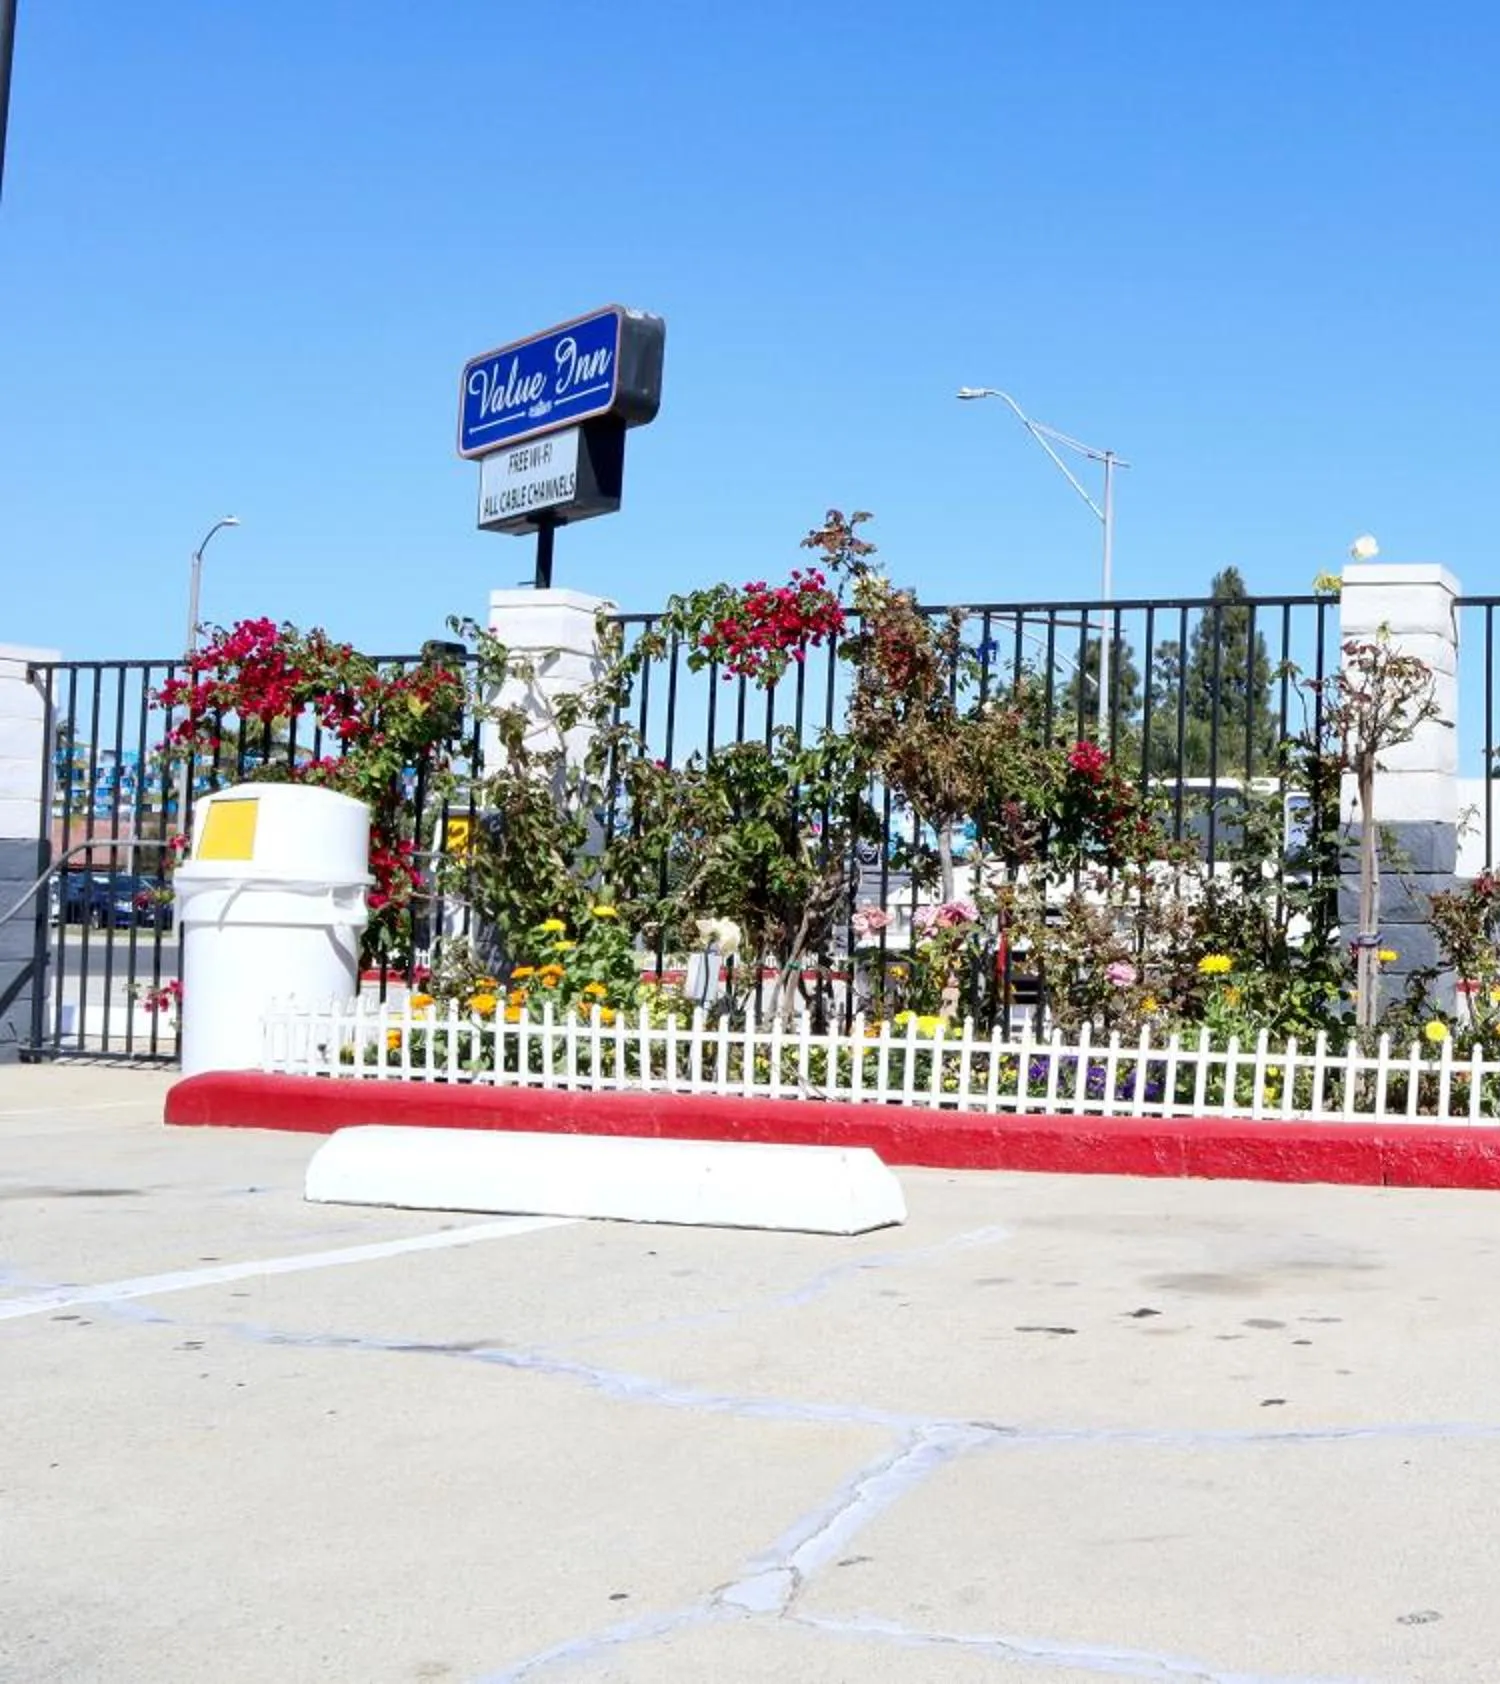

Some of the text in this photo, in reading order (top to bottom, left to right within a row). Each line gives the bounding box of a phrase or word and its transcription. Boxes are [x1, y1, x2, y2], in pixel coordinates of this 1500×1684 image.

[469, 337, 613, 419] Value Inn
[508, 448, 529, 475] FREE
[484, 472, 576, 519] ALL CABLE CHANNELS
